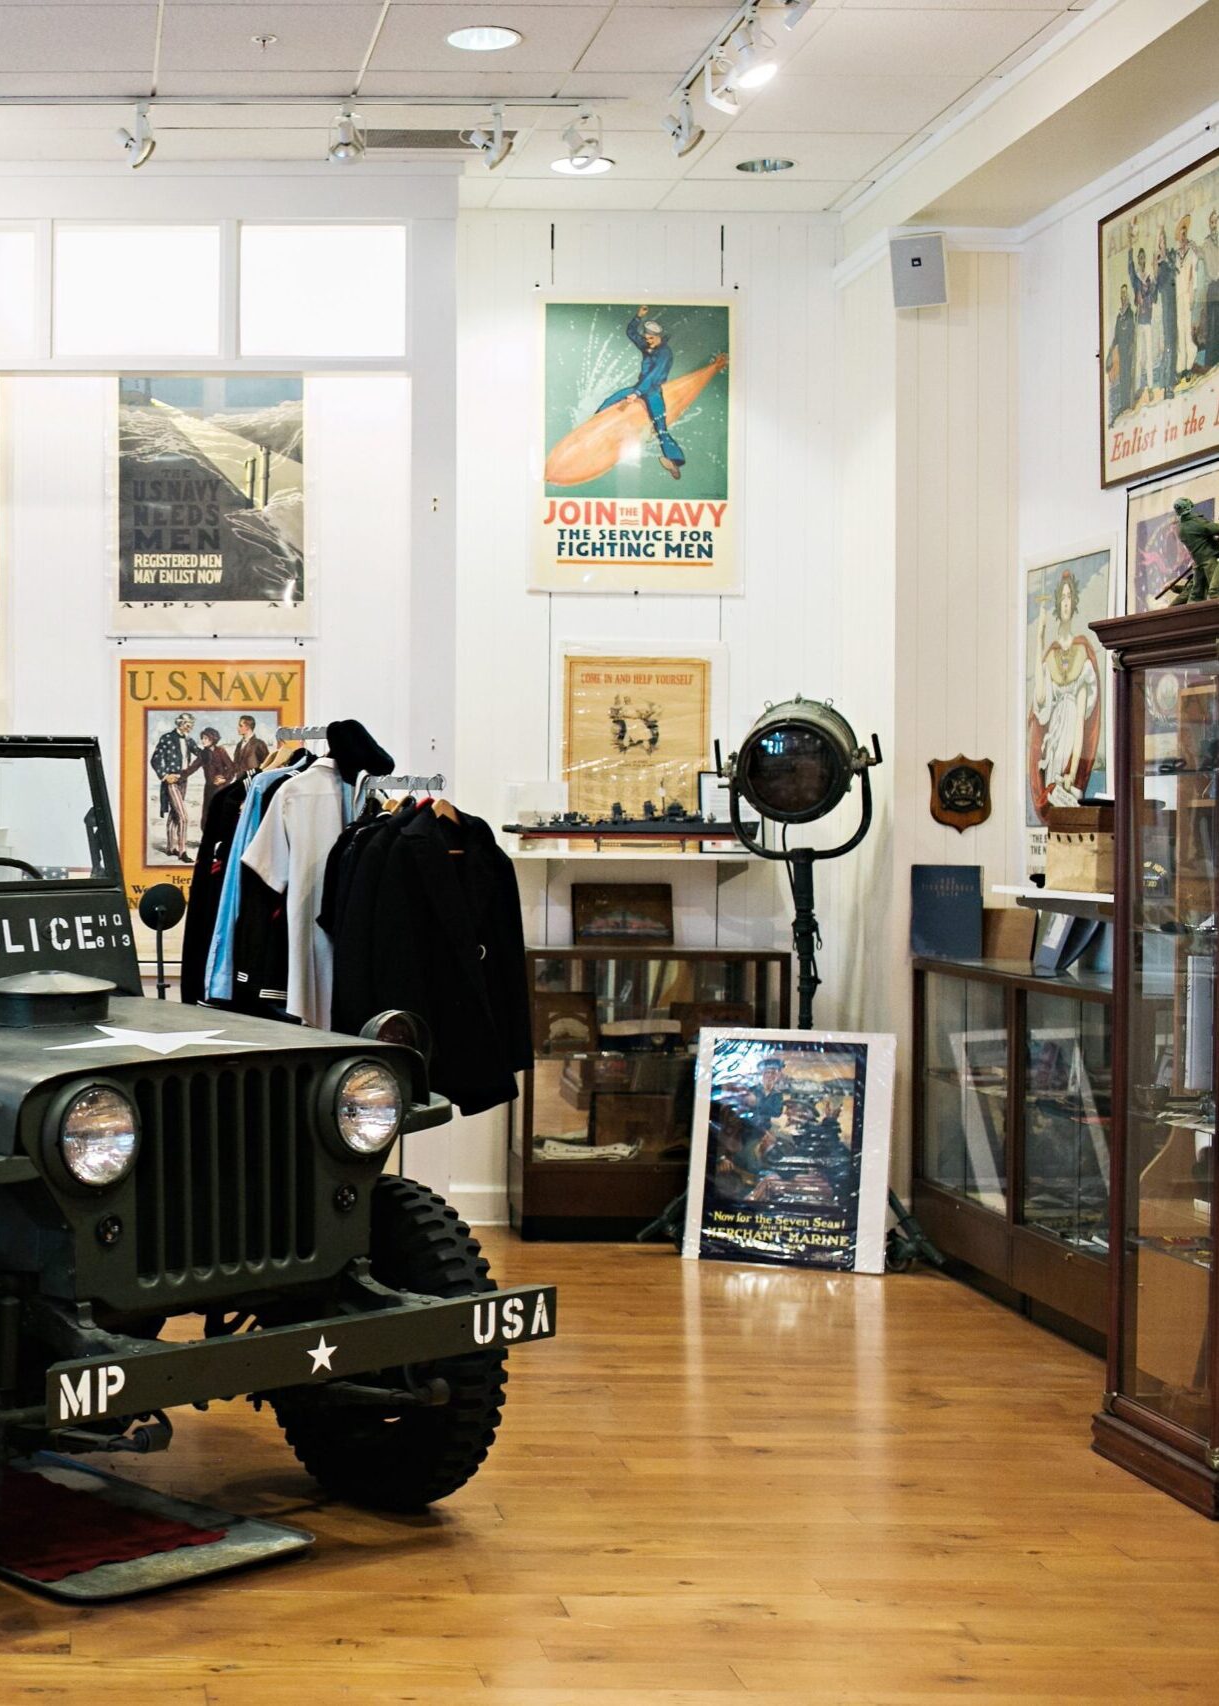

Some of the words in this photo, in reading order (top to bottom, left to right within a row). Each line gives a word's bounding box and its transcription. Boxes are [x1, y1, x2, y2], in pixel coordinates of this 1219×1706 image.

[1110, 425, 1158, 462] Enlist
[1164, 420, 1178, 443] in
[1183, 404, 1206, 436] the
[161, 468, 191, 478] THE
[134, 504, 220, 526] NEEDS
[543, 500, 616, 526] JOIN
[619, 507, 638, 517] THE
[642, 502, 728, 528] NAVY
[134, 528, 220, 550] MEN
[557, 529, 591, 540] THE
[598, 529, 673, 542] SERVICE
[680, 530, 713, 542] FOR
[133, 553, 198, 568] REGISTERED
[199, 553, 223, 568] MEN
[557, 542, 655, 557] FIGHTING
[664, 543, 713, 559] MEN
[133, 569, 155, 584] MAY
[159, 569, 196, 584] ENLIST
[197, 569, 223, 584] NOW
[198, 671, 298, 702] NAVY
[581, 673, 600, 684] COME
[604, 673, 613, 684] IN
[615, 674, 631, 684] AND
[633, 674, 652, 684] HELP
[655, 674, 694, 685] YOURSELF
[713, 1210, 735, 1222] Now
[736, 1212, 752, 1223] for
[755, 1214, 772, 1225] the
[775, 1215, 810, 1227] Seven
[813, 1217, 846, 1230] Seas!
[788, 1231, 850, 1247] MARINE
[473, 1292, 550, 1345] USA
[60, 1365, 126, 1420] MP
